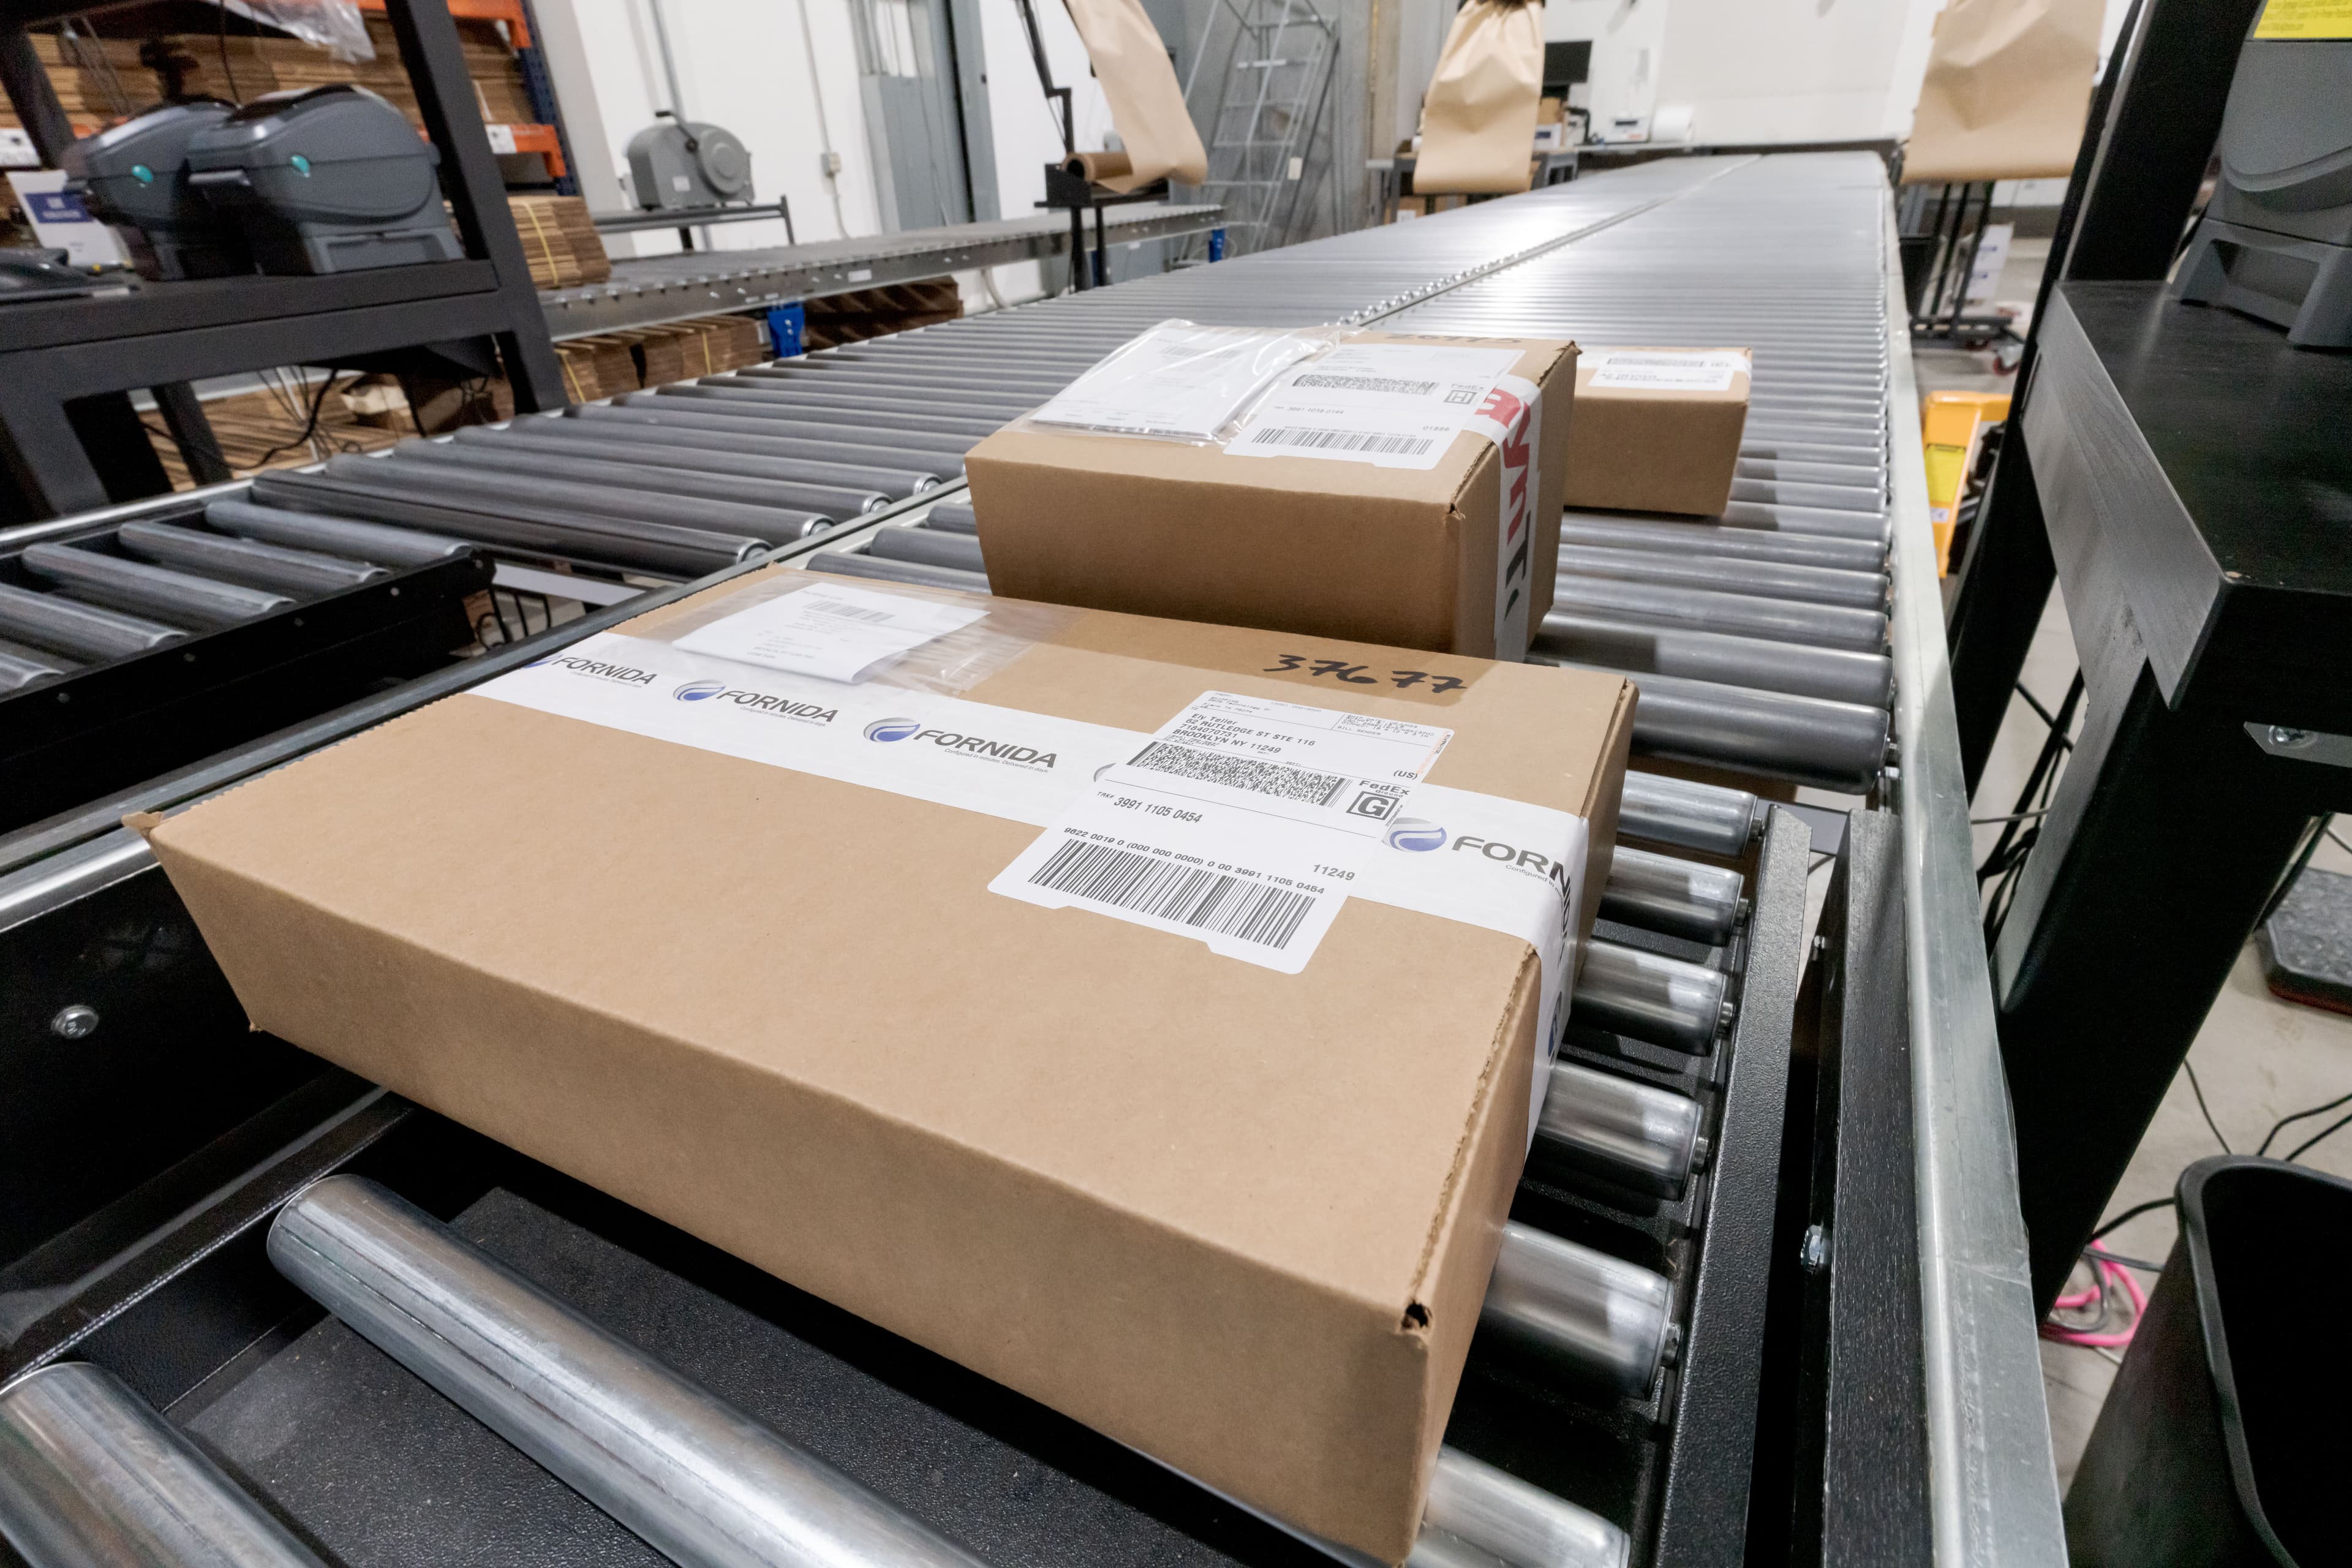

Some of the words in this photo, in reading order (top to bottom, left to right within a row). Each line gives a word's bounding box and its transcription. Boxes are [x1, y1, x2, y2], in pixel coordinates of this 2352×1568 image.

[552, 657, 657, 684] FORNIDA
[716, 690, 838, 722] FORNIDA
[1180, 723, 1238, 738] 7184070731
[1210, 716, 1238, 725] Teller
[1172, 729, 1229, 743] BROOKLYN
[1250, 743, 1281, 753] 11249
[1200, 721, 1254, 735] RUTLEDGE
[1273, 734, 1294, 742] STE
[913, 729, 1057, 768] FORNIDA
[944, 748, 973, 758] Configured
[1002, 760, 1028, 769] Delivered
[1393, 770, 1418, 780] (US)
[1359, 780, 1411, 795] FedEx
[1114, 797, 1143, 810] 3991
[1145, 804, 1173, 816] 1105
[1172, 809, 1203, 823] 0454
[1357, 796, 1389, 816] G
[1064, 827, 1088, 837] 9622
[1090, 834, 1115, 843] 0019
[1126, 842, 1150, 852] (000
[1152, 848, 1172, 858] 000
[1174, 854, 1204, 865] 0000)
[1234, 867, 1262, 878] 3991
[1267, 875, 1294, 886] 1105
[1296, 882, 1325, 894] 0454
[1313, 864, 1355, 881] 11249
[1506, 864, 1547, 883] Configured
